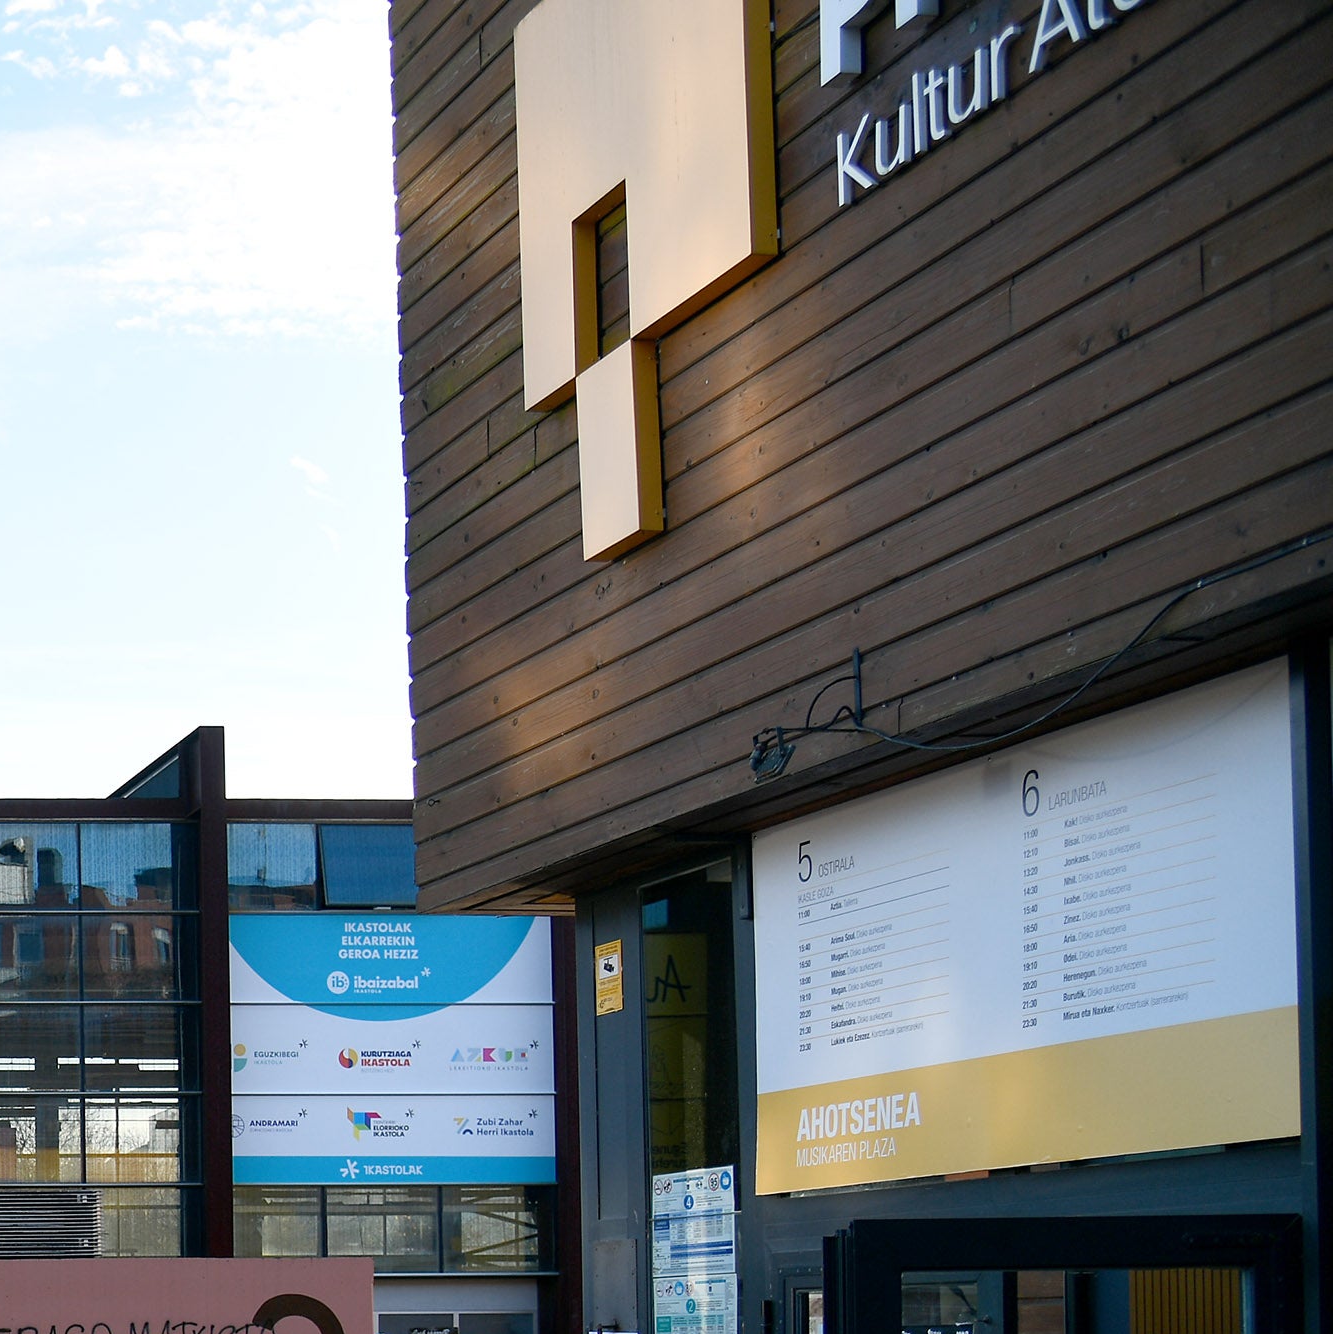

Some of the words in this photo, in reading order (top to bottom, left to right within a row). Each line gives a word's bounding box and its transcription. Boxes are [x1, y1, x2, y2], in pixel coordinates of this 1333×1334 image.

[836, 25, 1021, 207] Kultur
[1022, 770, 1039, 817] 6
[1048, 781, 1107, 810] LARUNBATA
[1024, 829, 1038, 840] 11:00
[798, 840, 813, 882] 5
[818, 856, 854, 878] OSTIRALA
[798, 909, 810, 920] 11:00
[344, 922, 412, 933] IKASTOLAK
[341, 936, 415, 946] ELKARREKIN
[338, 949, 380, 960] GEROA
[384, 949, 419, 959] HEZIZ
[354, 976, 418, 989] ibaizabal
[361, 1059, 410, 1067] IKASTOLA
[477, 1118, 496, 1126] Zubi
[498, 1118, 523, 1126] Zahar
[796, 1091, 921, 1143] AHOTSENEA
[477, 1128, 498, 1136] Herri
[501, 1128, 533, 1136] Ikastola
[795, 1140, 857, 1168] MUSIKAREN
[859, 1136, 897, 1162] PLAZA
[363, 1165, 423, 1175] IKASTOLAK
